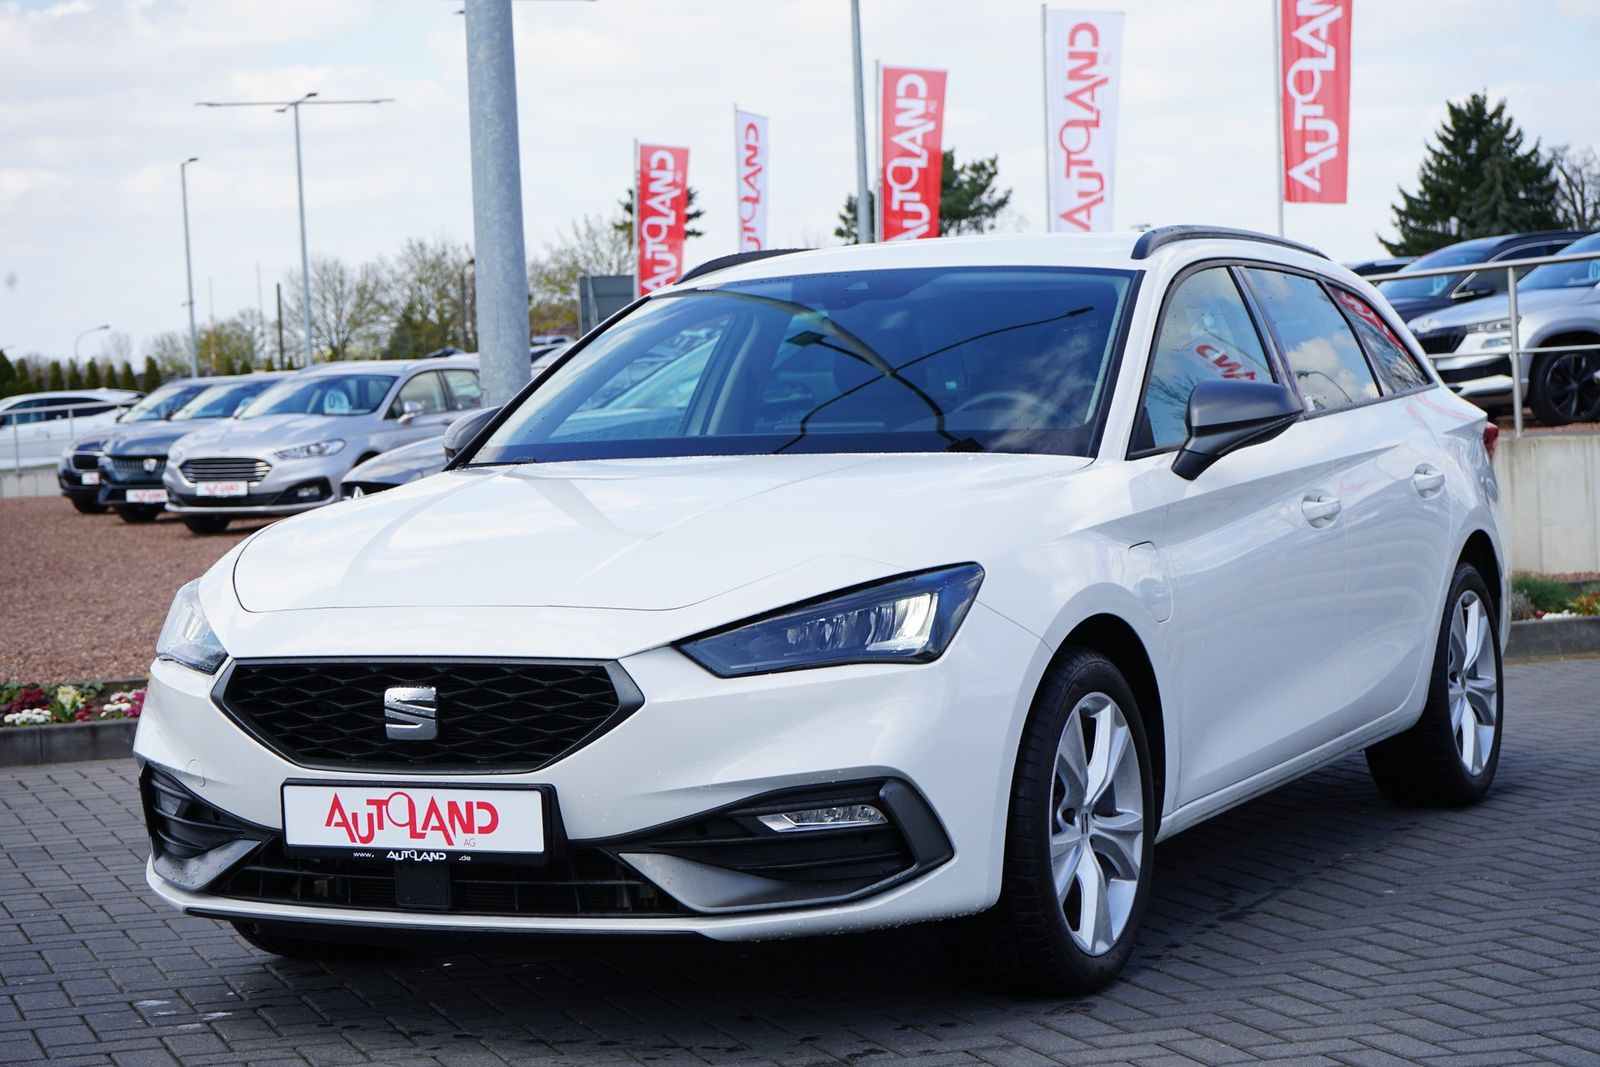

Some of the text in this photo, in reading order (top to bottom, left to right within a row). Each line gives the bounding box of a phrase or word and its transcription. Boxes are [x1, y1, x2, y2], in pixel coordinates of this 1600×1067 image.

[1058, 22, 1109, 231] AUTOLAND
[740, 122, 763, 251] UTOLAND
[325, 791, 499, 846] AUTOLAND
[463, 838, 476, 848] AG
[386, 850, 447, 862] AUTOLAND
